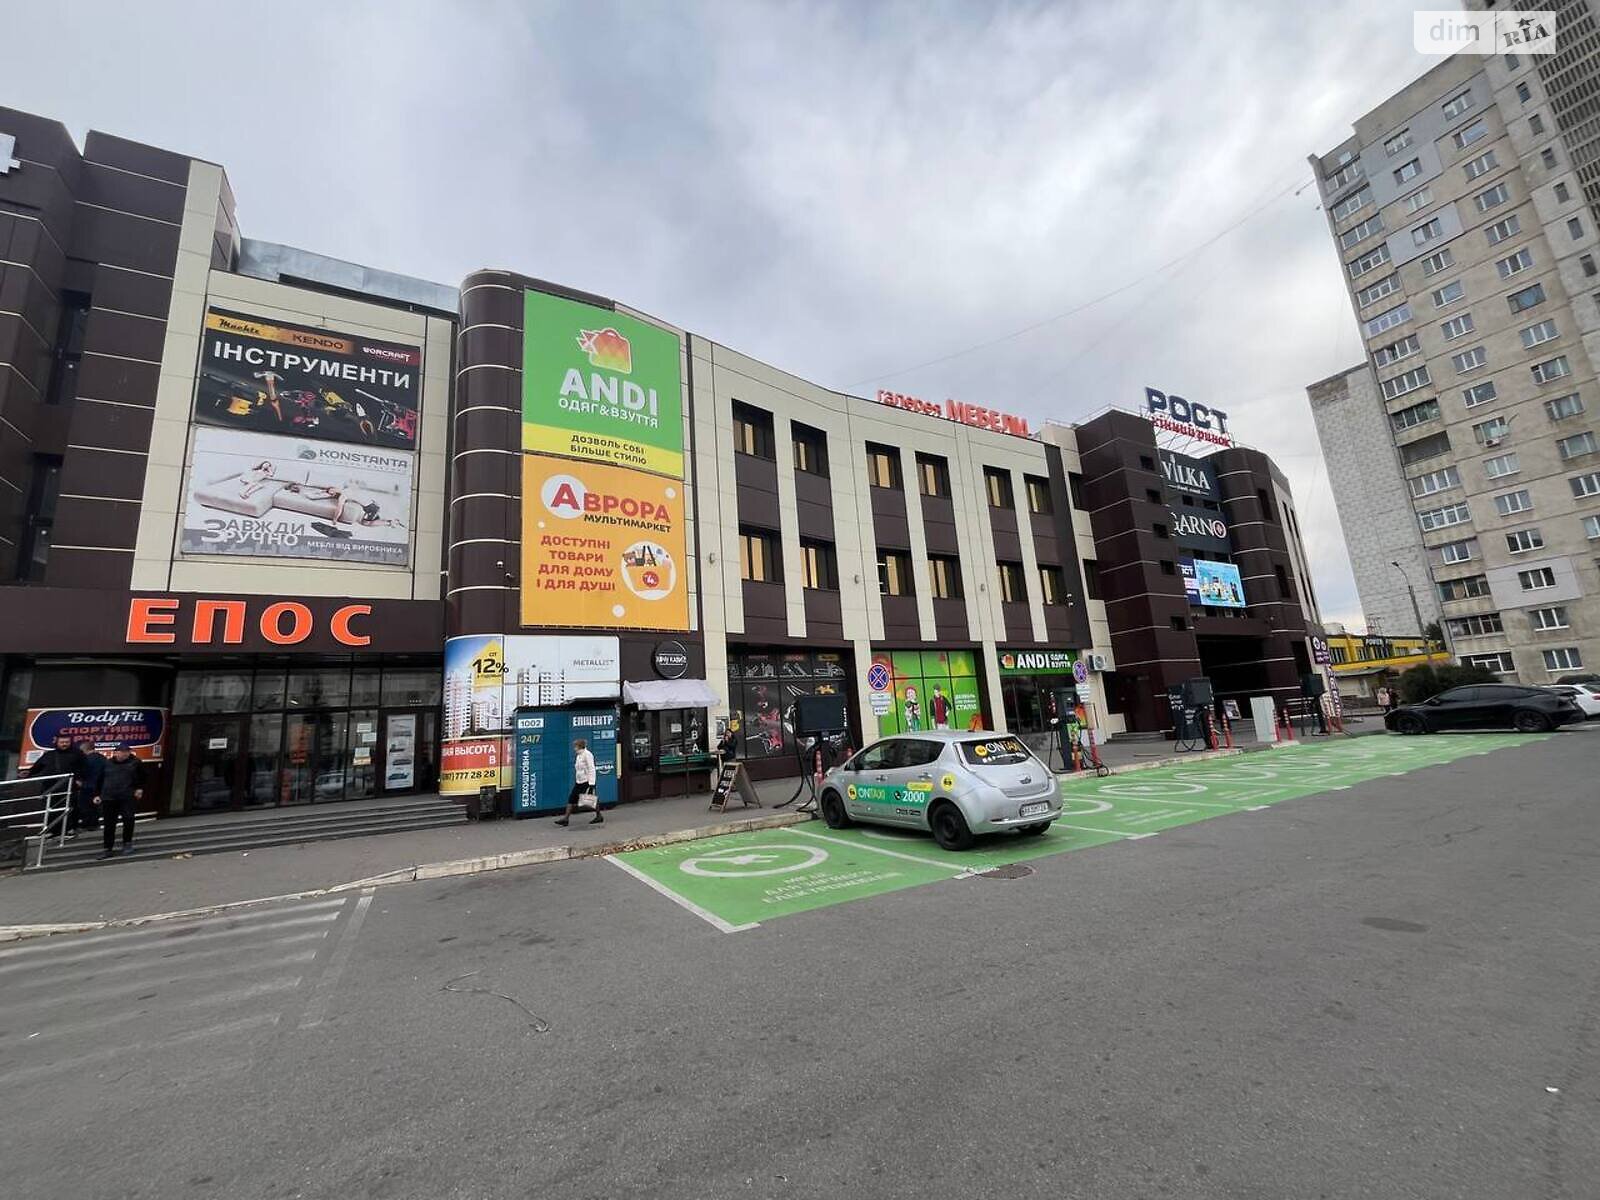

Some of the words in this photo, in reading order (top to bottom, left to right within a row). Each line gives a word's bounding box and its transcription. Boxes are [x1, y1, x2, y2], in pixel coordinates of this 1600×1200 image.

[293, 335, 344, 350] KENDO
[213, 340, 410, 389] ІНСТРУМЕНТИ
[560, 368, 657, 416] ANDI
[1145, 387, 1228, 434] РОСТ
[571, 434, 621, 449] ДОЗВОЛЬ
[623, 441, 645, 455] СОБІ
[319, 449, 408, 468] KONSTANTA
[570, 444, 612, 458] БІЛЬШЕ
[614, 451, 647, 465] СТИЛЮ
[1161, 454, 1211, 490] VILKA
[550, 483, 671, 523] АВРОРА
[583, 514, 672, 533] МУЛЬТИМАРКЕТ
[201, 518, 305, 545] ЗАВЖДИ
[541, 535, 610, 549] ДОСТУПНІ
[549, 550, 604, 563] ТОВАРИ
[538, 564, 570, 576] ДЛЯ
[573, 566, 614, 578] ДОМУ
[536, 579, 541, 588] І
[544, 580, 576, 590] ДЛЯ
[579, 580, 615, 592] ДУШІ
[126, 599, 373, 646] ЕПОС
[472, 658, 510, 673] 12%
[1017, 653, 1050, 669] ANDI
[520, 720, 541, 729] 1002
[572, 715, 614, 727] ЕПІЦЕНТР
[59, 725, 147, 736] СПОРТИВНЕ
[521, 734, 541, 744] 24/7
[454, 744, 496, 756] ВЫСОТА
[488, 755, 496, 765] В
[470, 771, 481, 779] 28
[483, 770, 496, 778] 28
[521, 749, 530, 807] БЕЗКОШТОВНА
[902, 791, 925, 803] 2000
